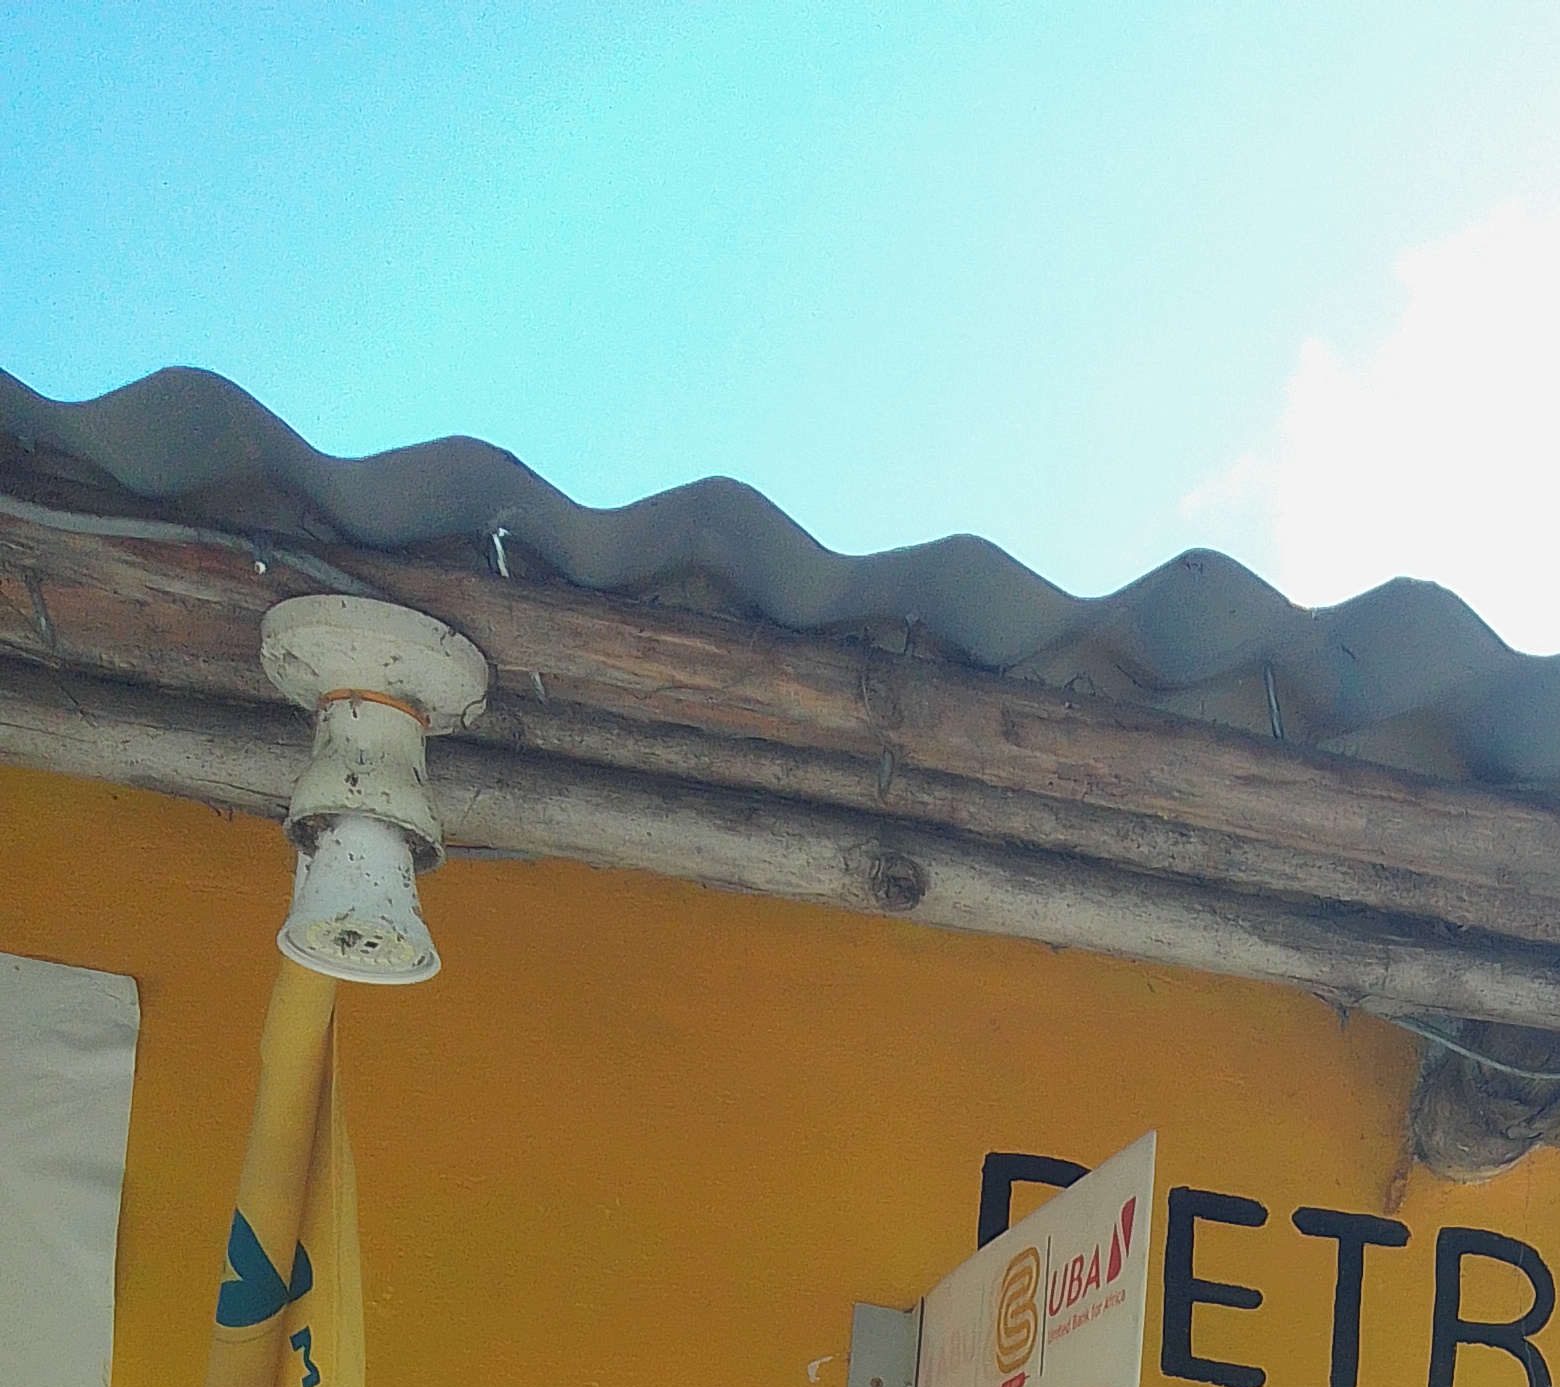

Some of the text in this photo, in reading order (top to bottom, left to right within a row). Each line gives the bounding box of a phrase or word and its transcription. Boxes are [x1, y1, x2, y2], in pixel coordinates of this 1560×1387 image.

[1049, 1243, 1101, 1318] UBA
[1072, 1306, 1090, 1330] Bank
[1091, 1303, 1101, 1322] for
[1103, 1288, 1126, 1312] Africa
